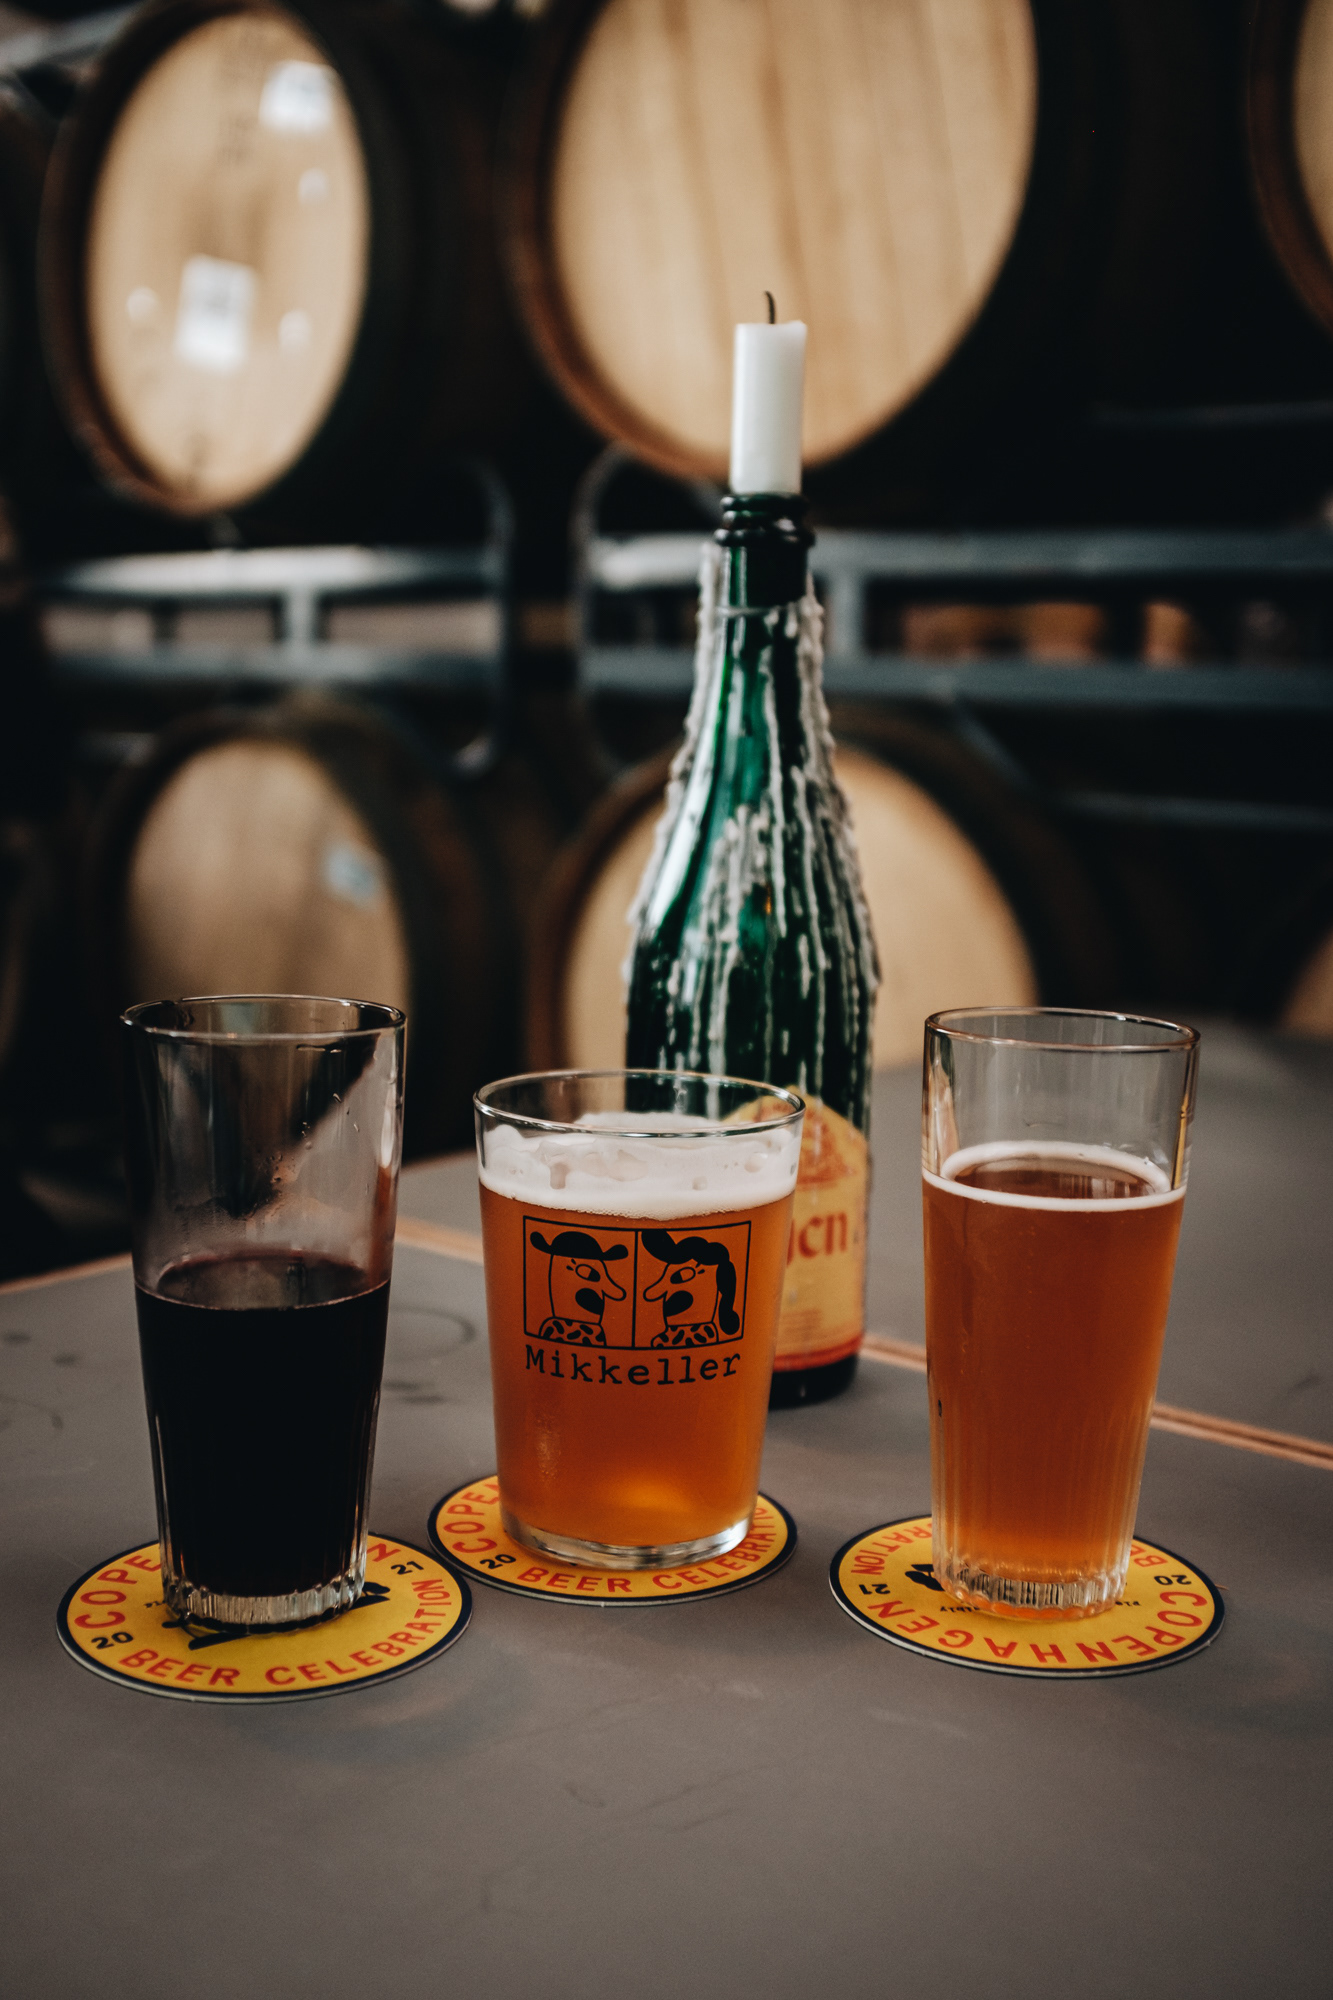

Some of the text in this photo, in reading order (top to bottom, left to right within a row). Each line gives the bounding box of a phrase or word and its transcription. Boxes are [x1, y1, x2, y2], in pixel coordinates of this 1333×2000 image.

[525, 1344, 741, 1386] Mikkeller
[480, 1554, 517, 1570] 20
[517, 1507, 777, 1593] BEER CELEBRATIO
[851, 1523, 932, 1576] RATION
[391, 1561, 425, 1576] 21
[1154, 1574, 1192, 1586] 20
[859, 1584, 891, 1595] 21
[91, 1631, 134, 1650] 20
[118, 1578, 452, 1687] BEER CELEBRATION
[867, 1591, 1208, 1663] COPENHAGEN
